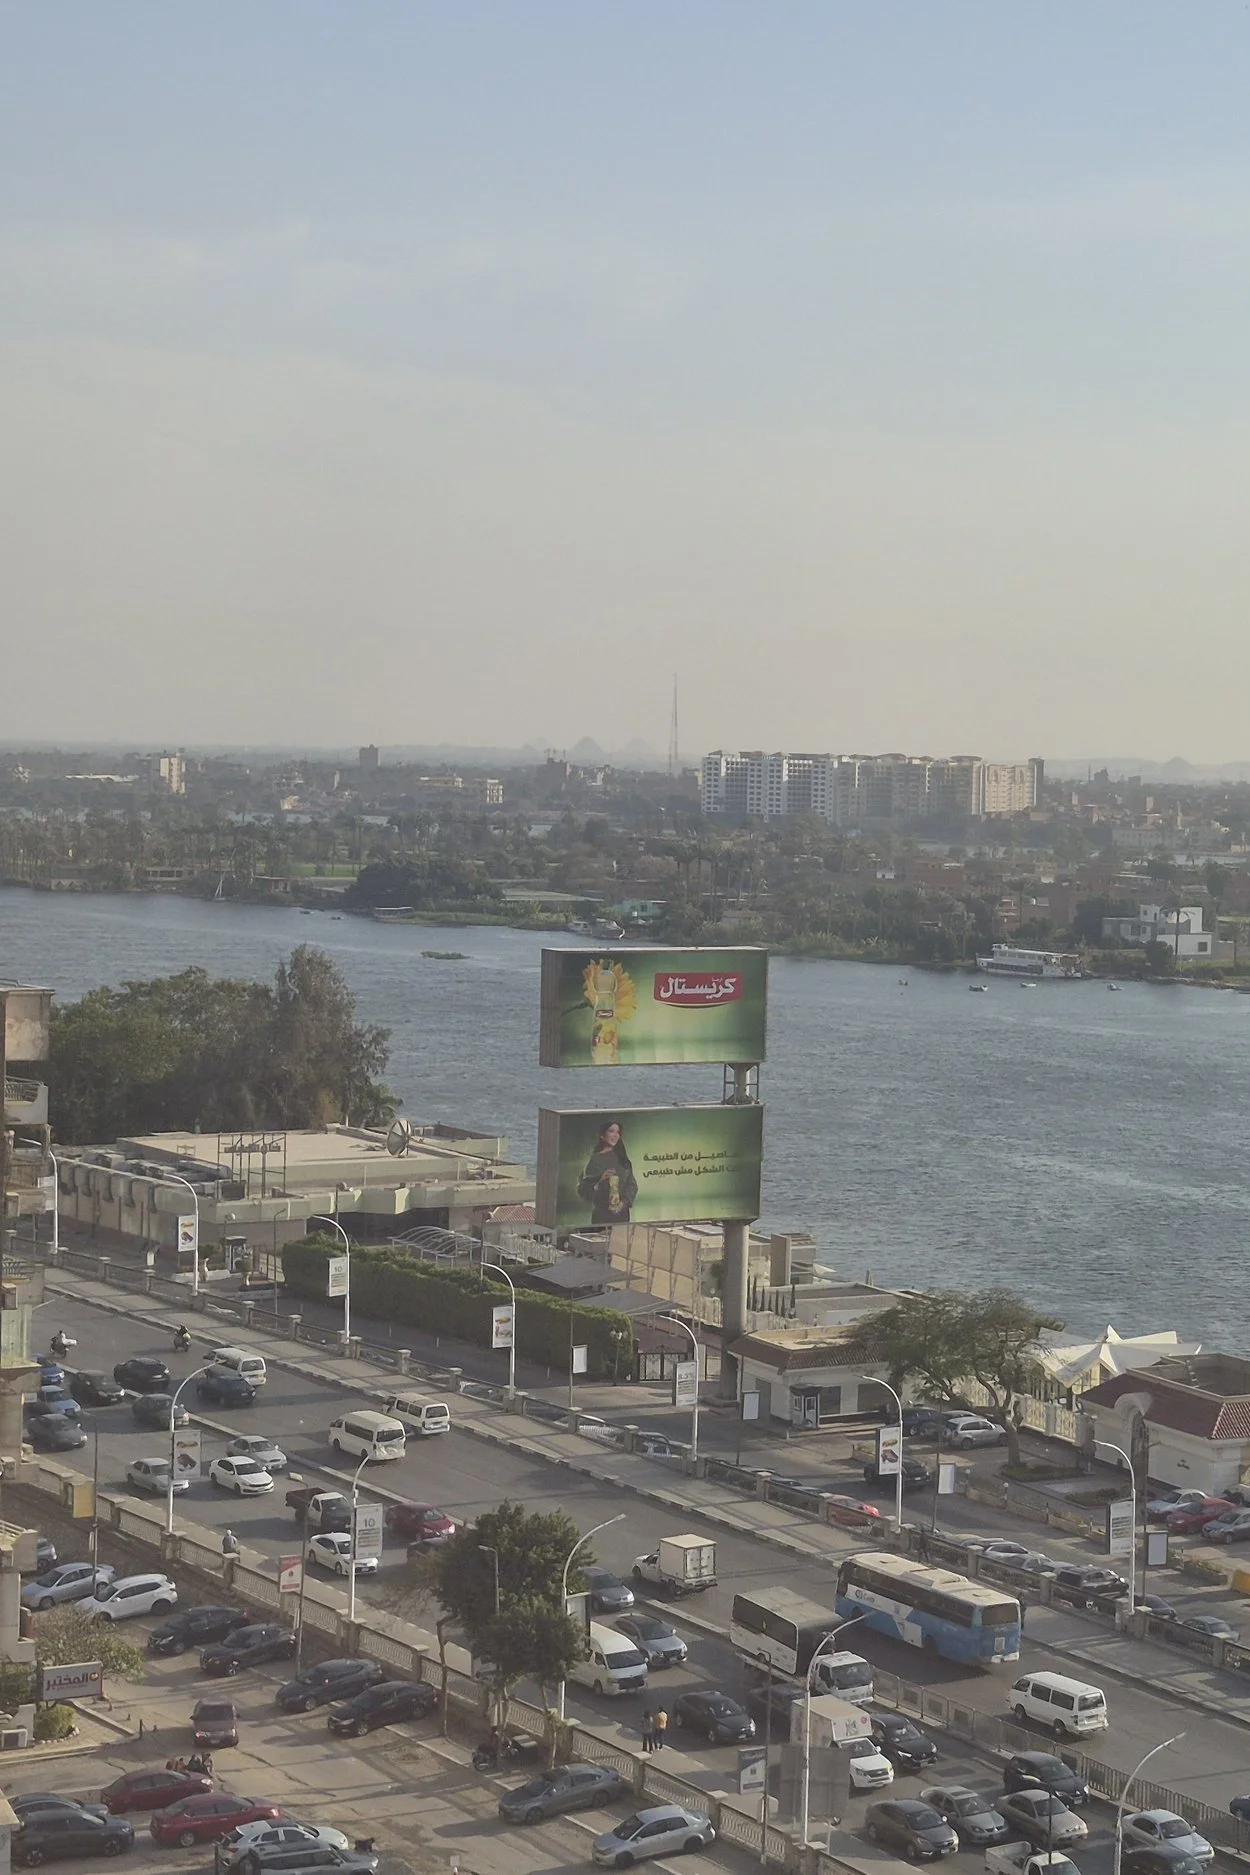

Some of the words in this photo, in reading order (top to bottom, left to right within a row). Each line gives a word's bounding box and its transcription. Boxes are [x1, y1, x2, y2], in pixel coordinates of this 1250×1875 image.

[660, 976, 737, 999] كريستال
[643, 1152, 679, 1162] الطبيعة
[681, 1152, 693, 1161] من
[675, 1167, 693, 1176] مش
[695, 1165, 724, 1176] الشكل
[364, 1518, 376, 1528] 10
[45, 1672, 89, 1691] المختبر
